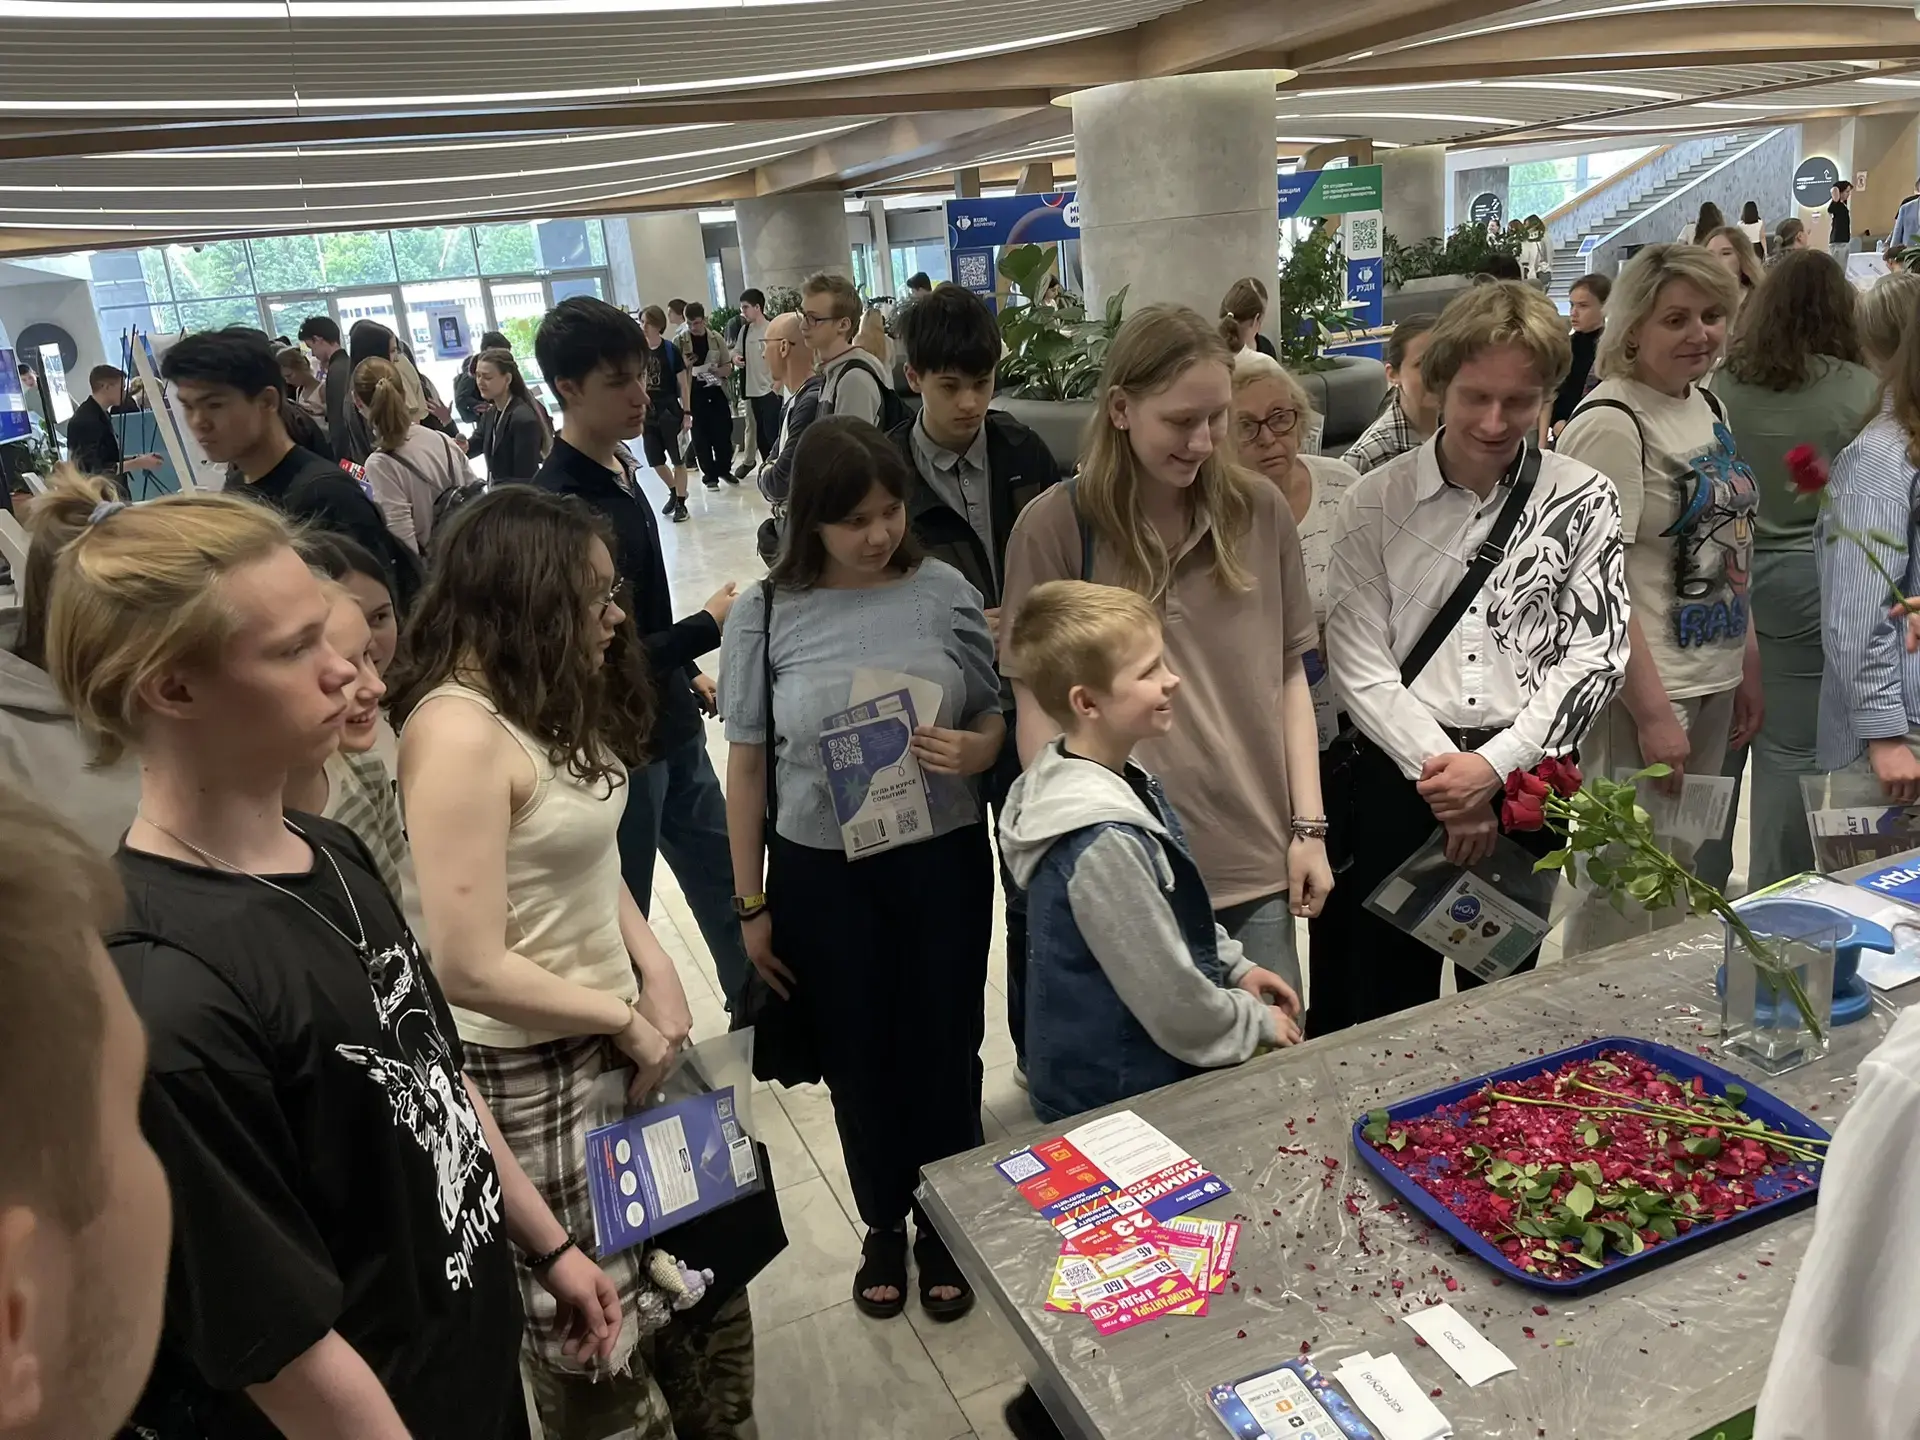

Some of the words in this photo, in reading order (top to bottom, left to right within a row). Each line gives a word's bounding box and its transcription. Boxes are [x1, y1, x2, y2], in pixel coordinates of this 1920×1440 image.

[1356, 282, 1376, 292] РУДН
[896, 778, 916, 790] КУРСЕ
[1158, 1162, 1190, 1180] РУДН
[1128, 1179, 1152, 1194] ЭТО
[1134, 1164, 1210, 1204] ХИМИЯ
[1078, 1208, 1114, 1227] UNIVERSITY
[1095, 1213, 1120, 1226] WORLD
[1112, 1212, 1152, 1237] 23
[1136, 1246, 1152, 1258] 46
[1154, 1260, 1172, 1273] 63
[1103, 1280, 1124, 1294] 160
[1146, 1288, 1155, 1300] В
[1118, 1292, 1147, 1310] РУДН
[1132, 1287, 1196, 1318] АСПИРАНТУРА
[1090, 1304, 1110, 1320] ЭТО
[1443, 1330, 1466, 1350] CoCl2
